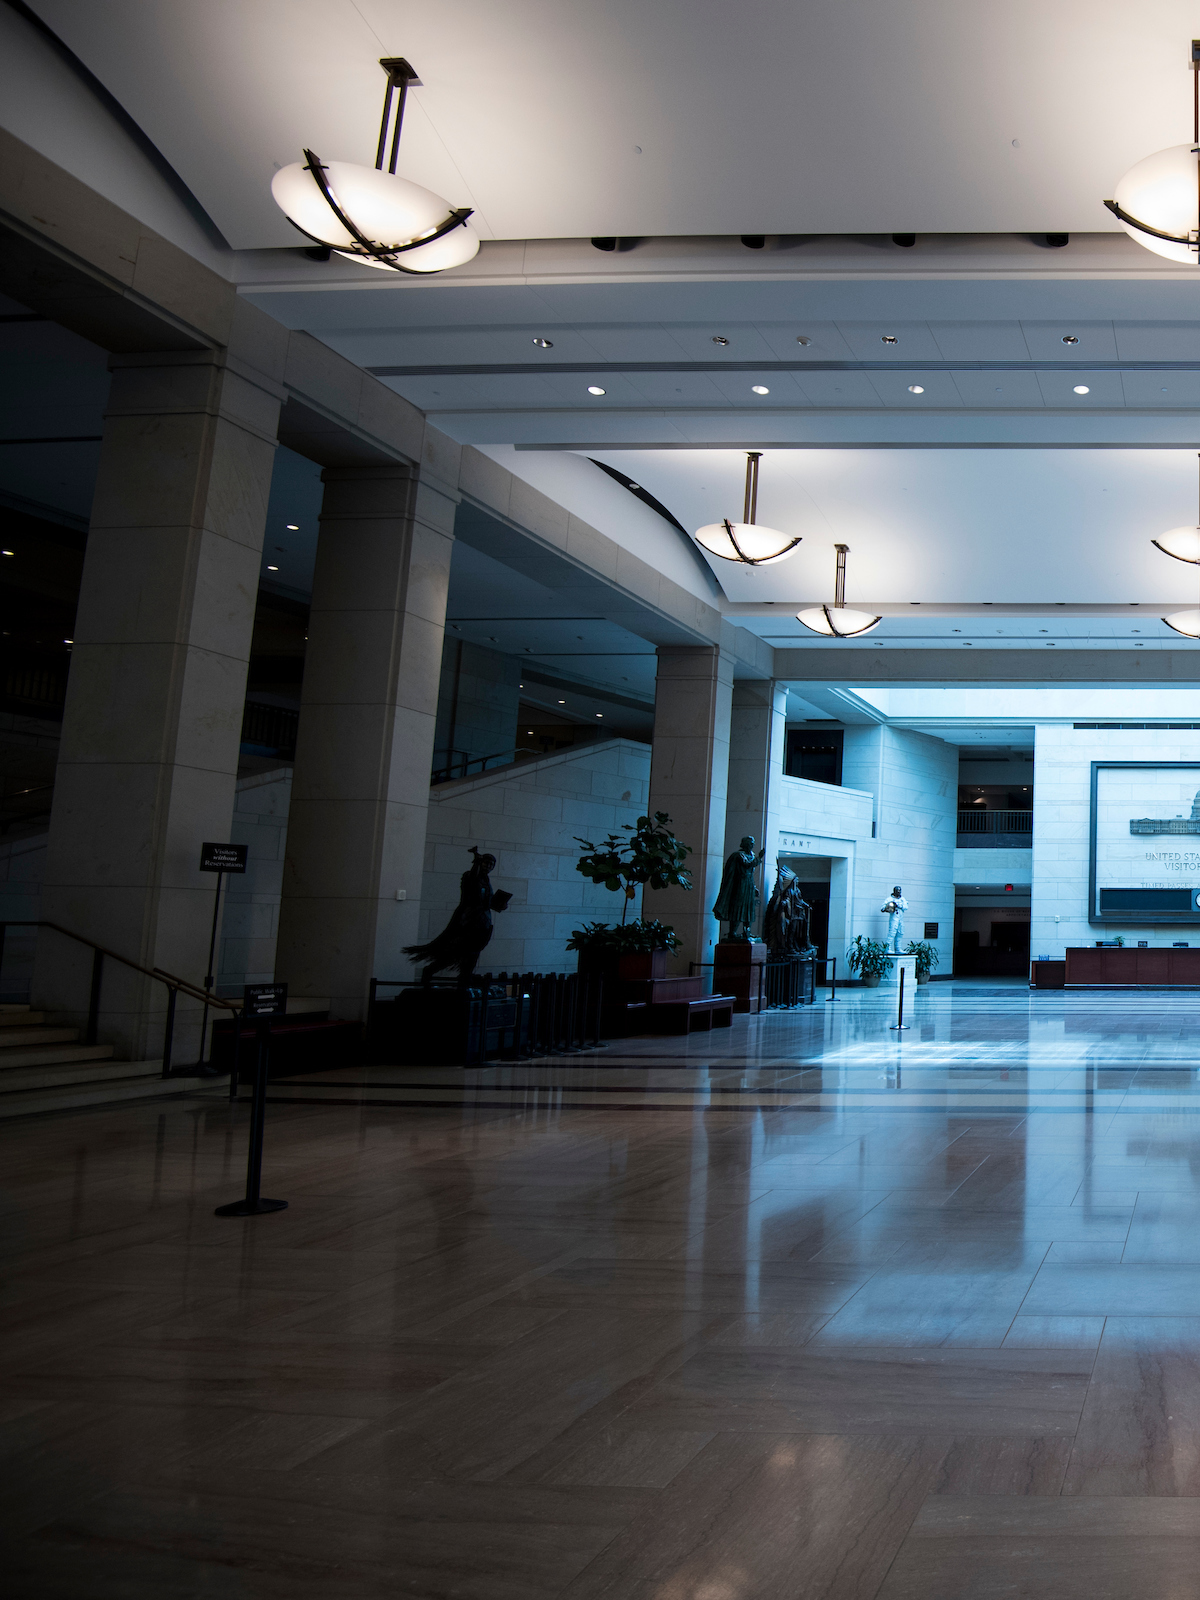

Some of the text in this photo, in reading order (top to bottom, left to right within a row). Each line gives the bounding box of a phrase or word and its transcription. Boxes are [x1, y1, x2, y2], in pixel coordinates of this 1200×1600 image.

[778, 838, 811, 848] RANT
[214, 848, 238, 856] Visitors
[1145, 852, 1181, 861] UNITED
[204, 859, 244, 868] Reservations
